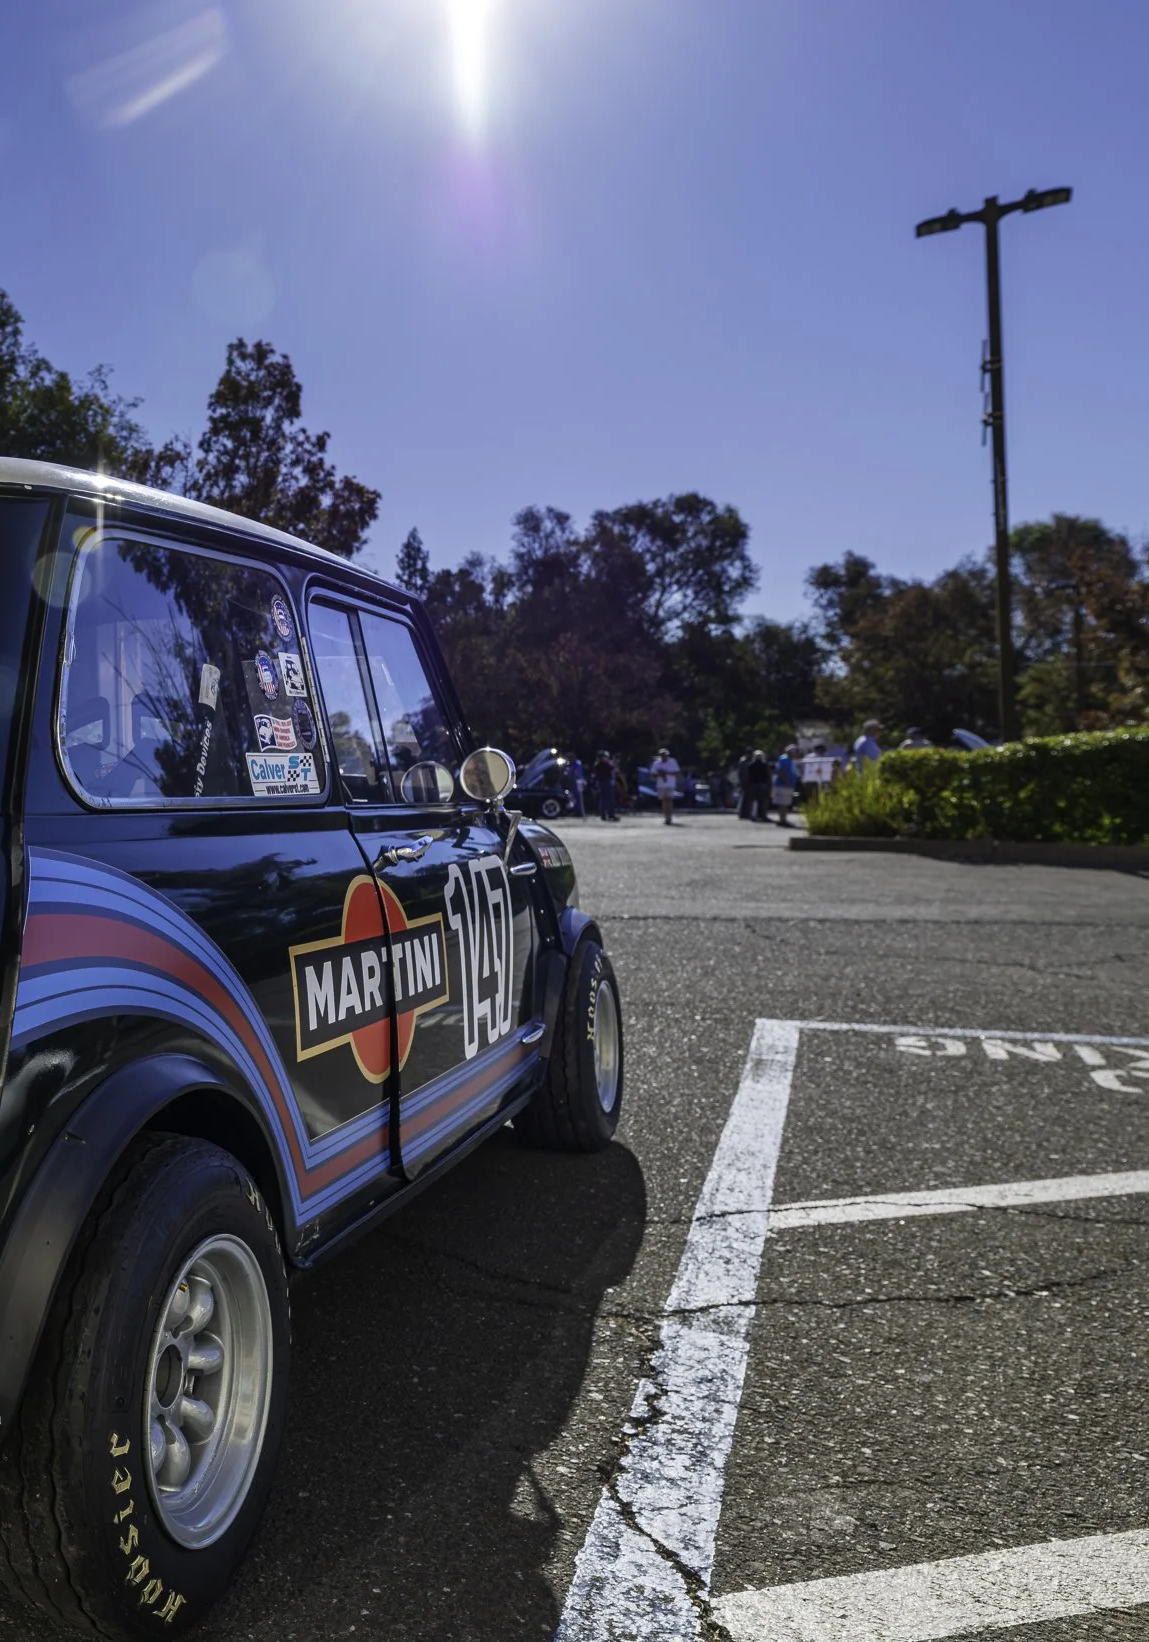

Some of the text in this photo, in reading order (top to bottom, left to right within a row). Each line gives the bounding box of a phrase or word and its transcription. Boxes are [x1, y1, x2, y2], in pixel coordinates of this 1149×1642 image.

[196, 720, 213, 776] Devices
[250, 758, 286, 781] Calver
[304, 932, 441, 1031] MARTINI
[443, 854, 514, 1060] 147
[109, 1430, 188, 1624] Hoosier
